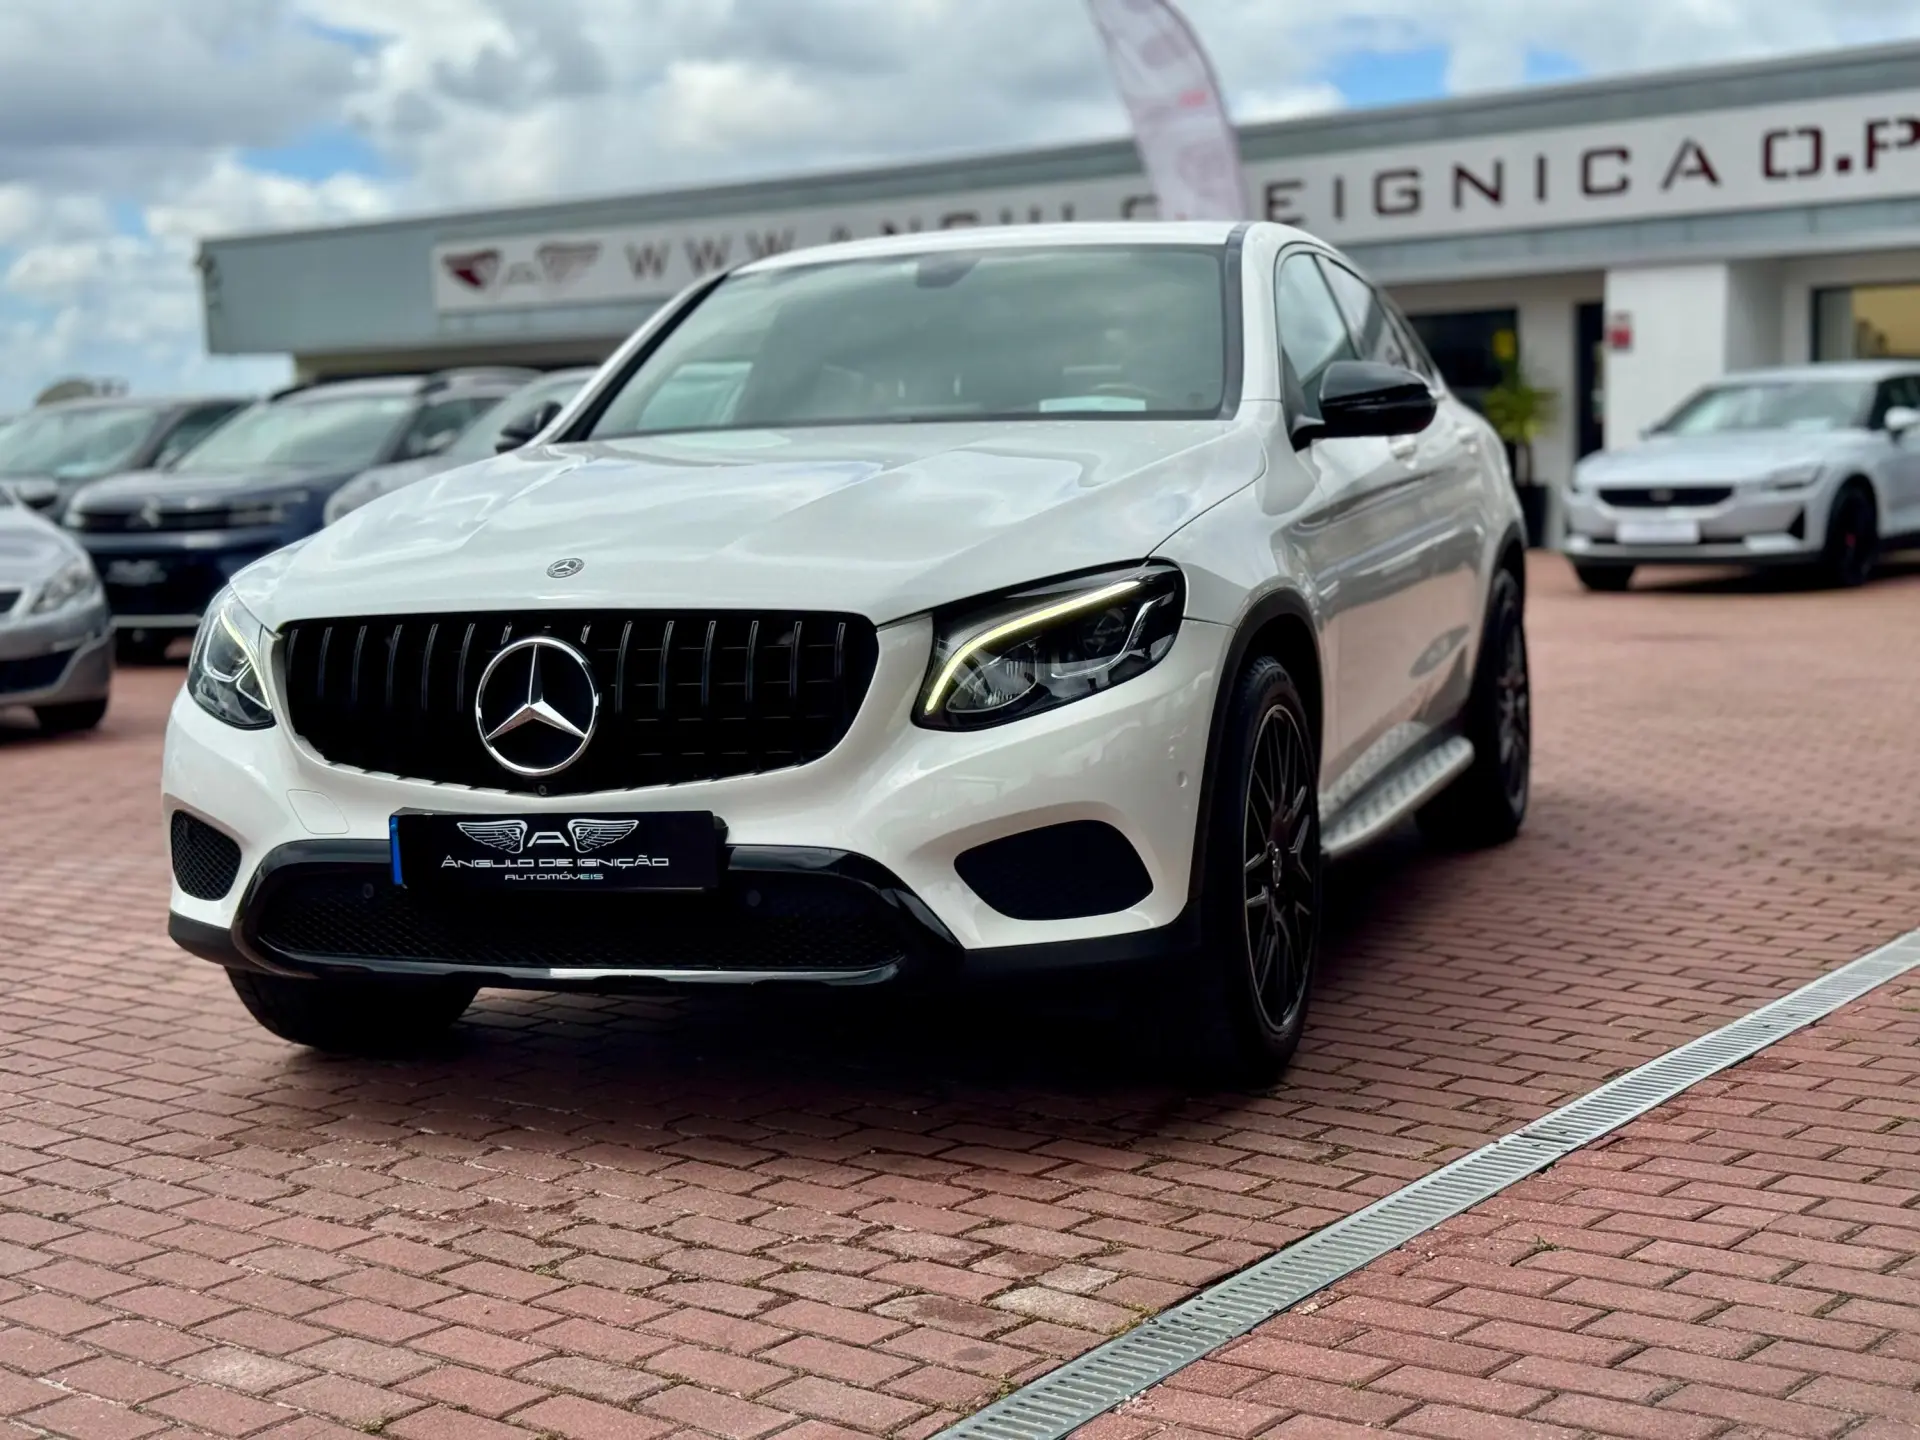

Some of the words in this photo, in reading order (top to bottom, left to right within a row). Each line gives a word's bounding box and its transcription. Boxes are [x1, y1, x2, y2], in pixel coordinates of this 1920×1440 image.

[526, 831, 571, 848] A
[441, 855, 534, 868] ÂNGULO
[538, 858, 573, 868] DE
[577, 854, 669, 870] IGNIÇÃO
[504, 871, 604, 881] AUTOMÓVEIS
